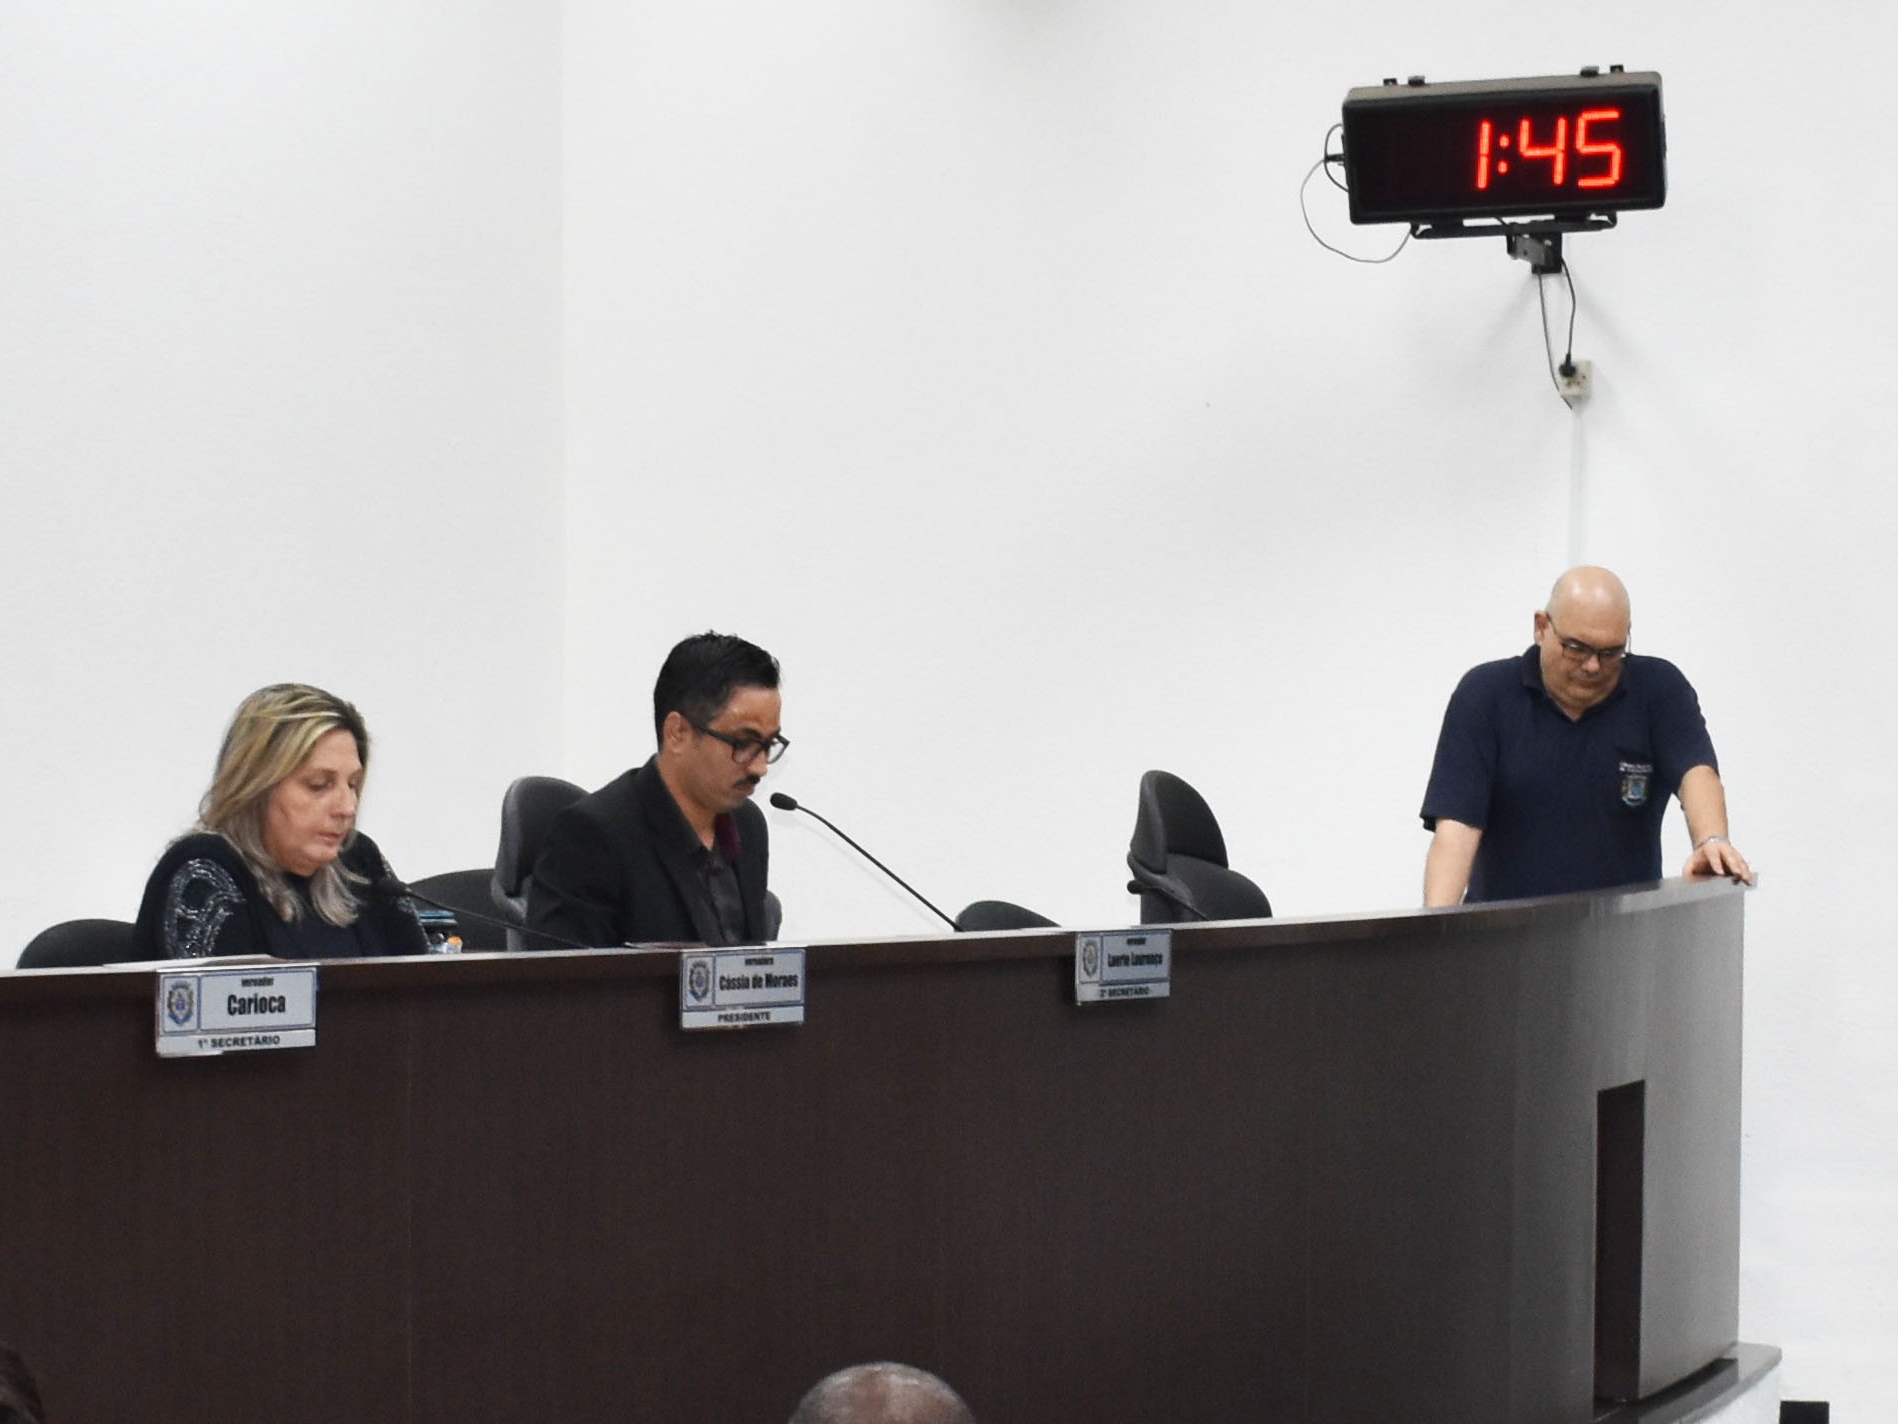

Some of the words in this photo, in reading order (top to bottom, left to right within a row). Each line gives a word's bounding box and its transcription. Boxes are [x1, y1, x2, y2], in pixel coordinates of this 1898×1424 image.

[1476, 108, 1624, 190] 1:45
[227, 993, 286, 1016] Carioca
[718, 1012, 771, 1023] PRESIDENTE
[211, 1035, 281, 1048] SECRETÁRIO
